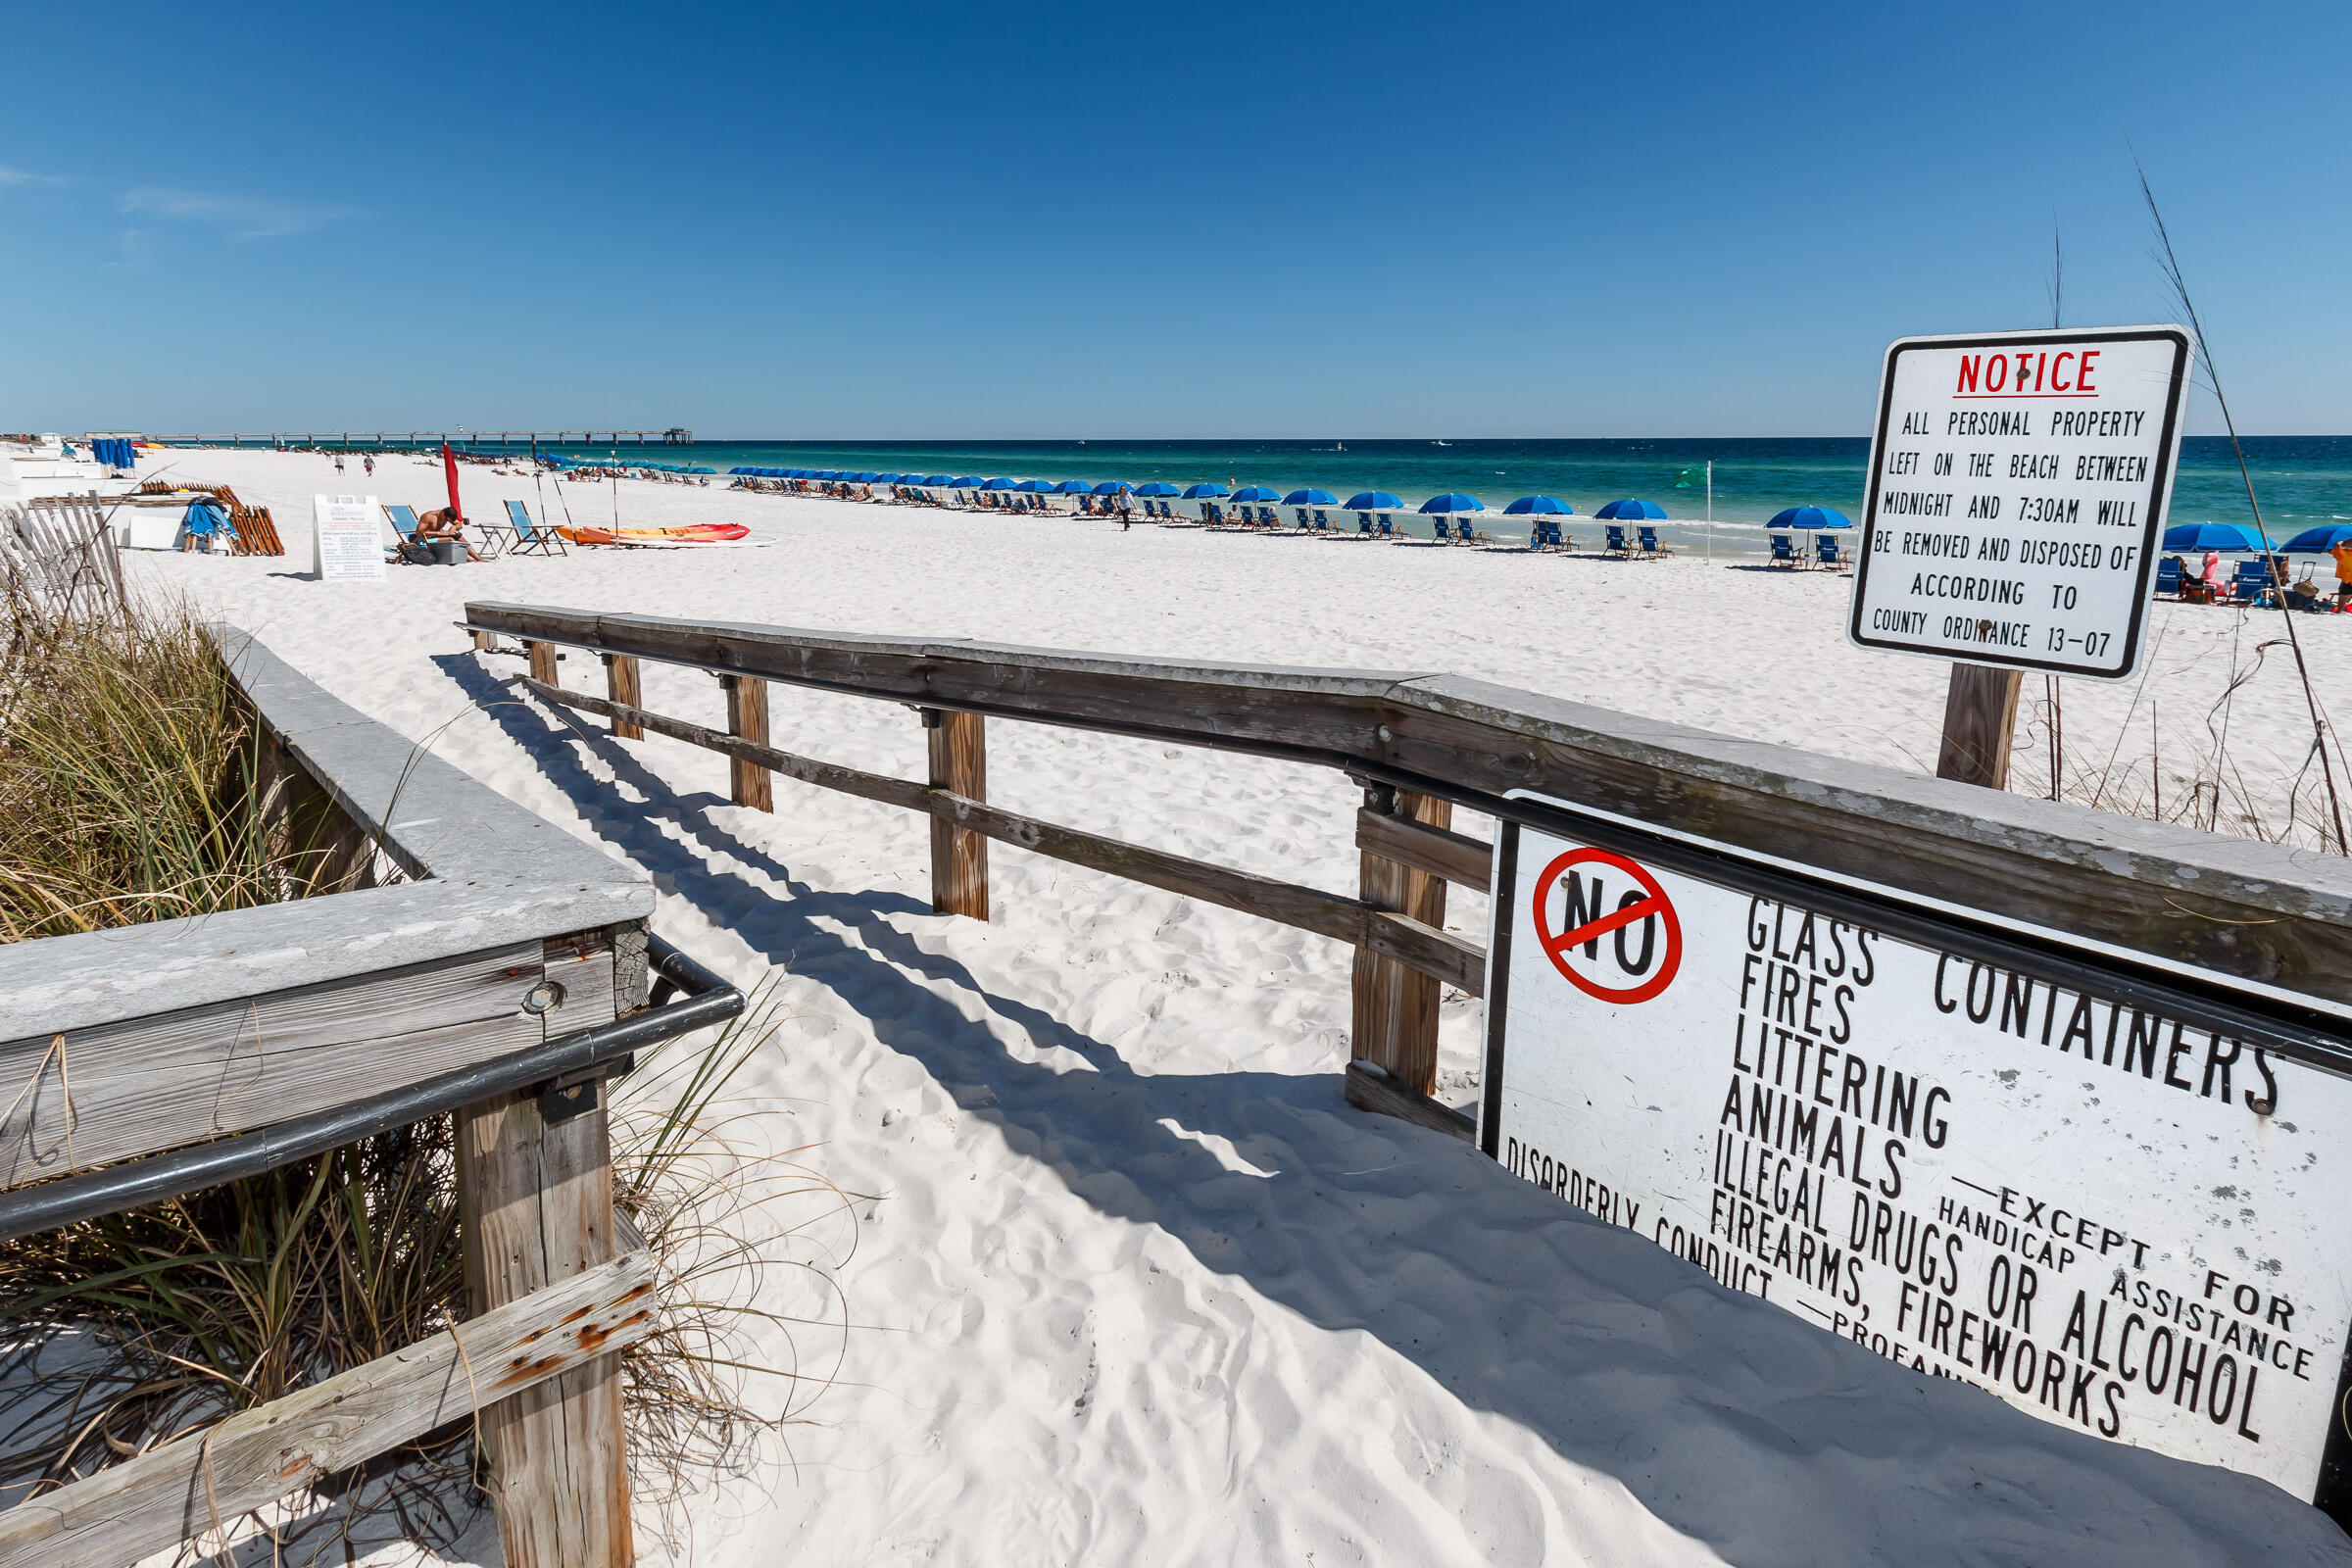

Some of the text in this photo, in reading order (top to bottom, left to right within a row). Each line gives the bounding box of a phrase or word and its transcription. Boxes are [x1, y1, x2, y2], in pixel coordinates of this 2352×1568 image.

[1957, 351, 2100, 392] NOTICE
[1902, 412, 2145, 436] ALL PERSONAL PROPERTY
[1889, 452, 2147, 482] LEFT ON THE BEACH BETWEEN
[1884, 492, 2136, 526] MIDNIGHT AND 7:30AM WILL
[1875, 530, 2136, 570] BE REMOVED AND DISPOSED OF
[1874, 609, 1928, 636] COUNTY
[1911, 573, 2077, 610] ACCORDING TO
[1567, 870, 1656, 976] NO
[1740, 953, 1854, 1045] FIRES
[1747, 896, 2285, 1115] GLASS CONTAINERS
[1734, 1013, 1950, 1149] LITTERING
[1721, 1074, 1905, 1199] ANIMALS
[1711, 1189, 2125, 1438] FIREARMS, FIREWORKS
[1714, 1129, 2260, 1444] ILLEGAL DRUGS OR ALCOHOL
[1939, 1197, 2313, 1381] HANDICAP ASSISTANCE
[2204, 1270, 2294, 1332] FOR
